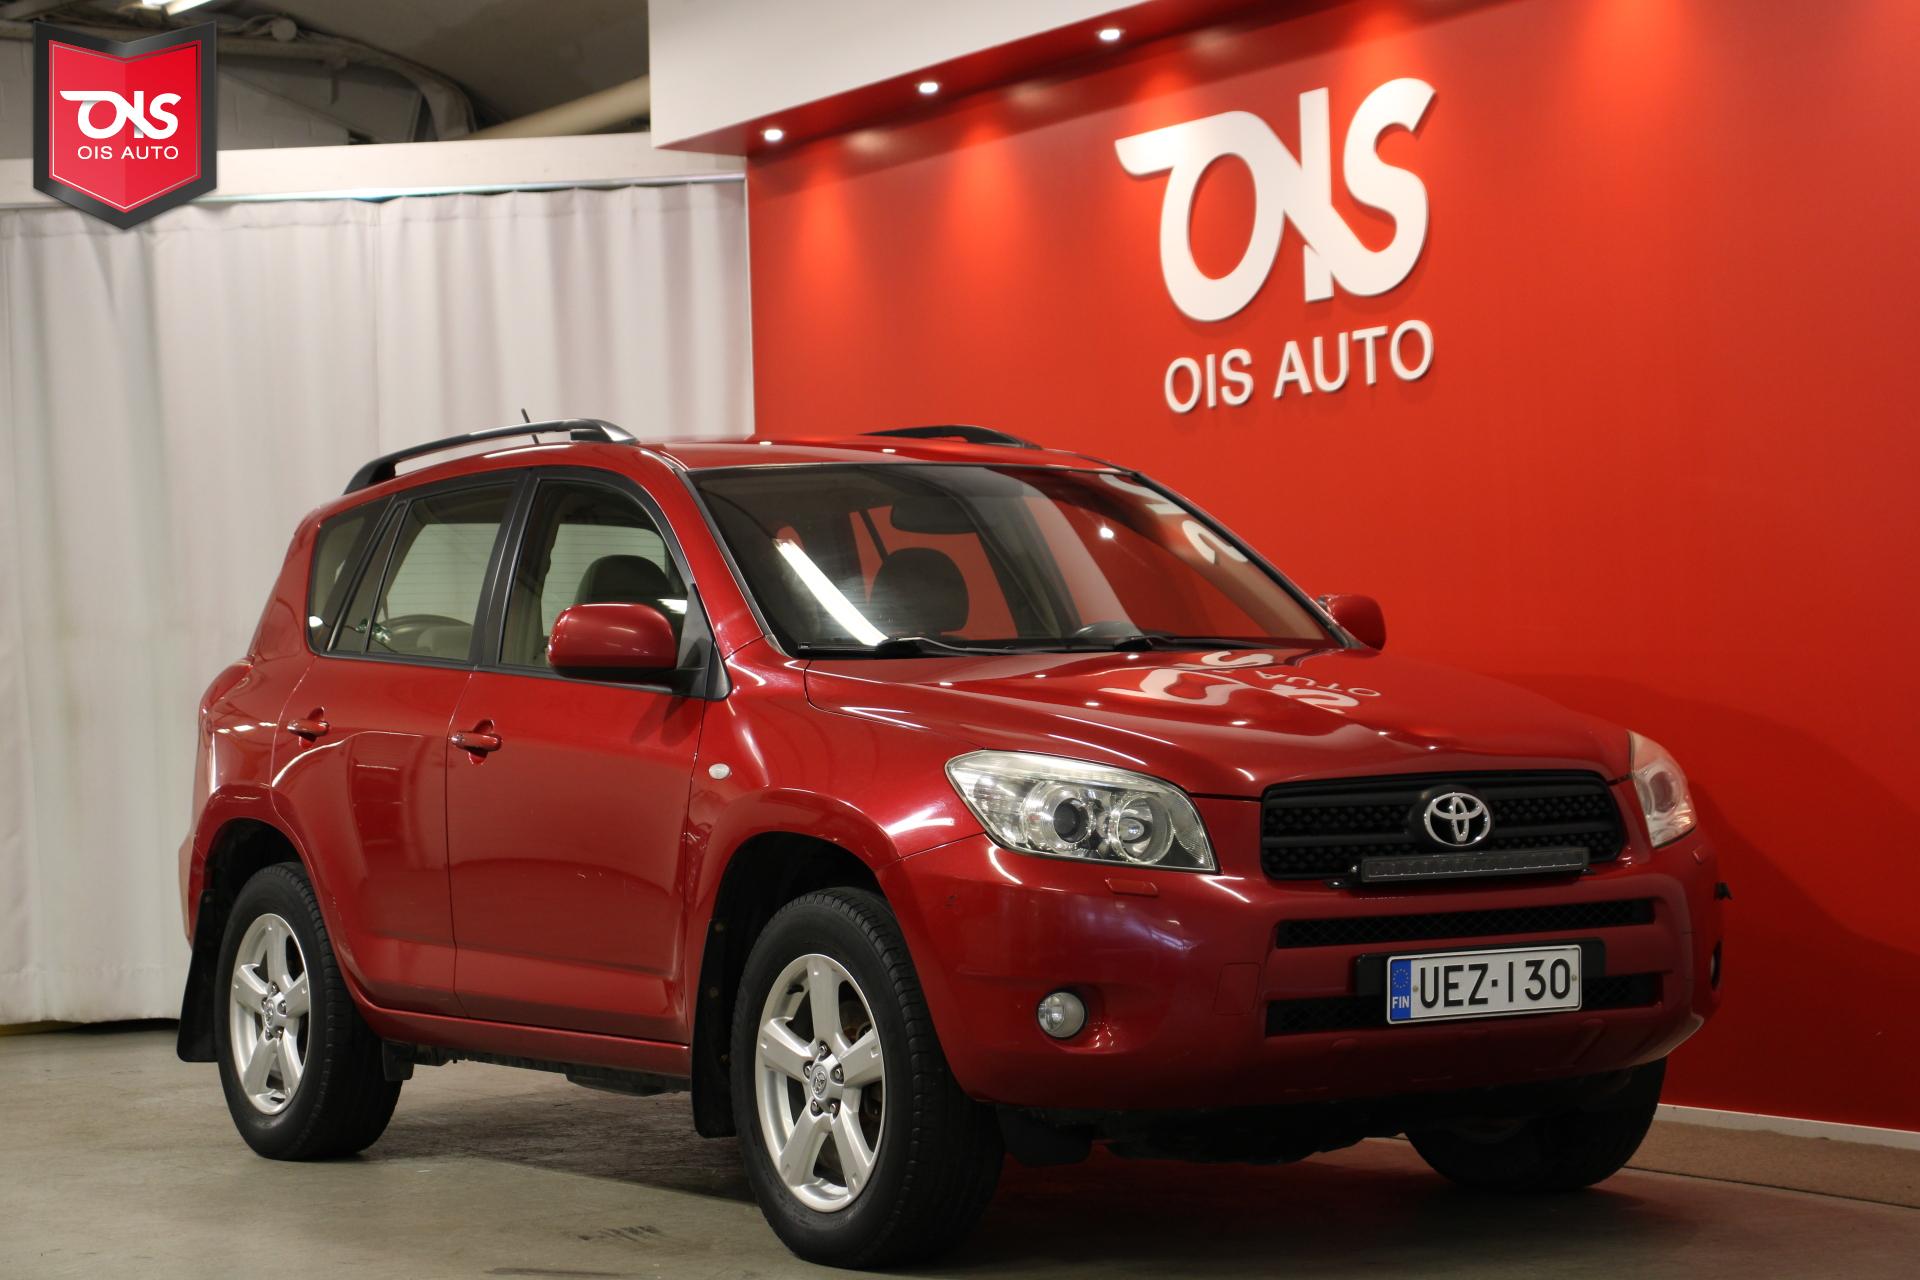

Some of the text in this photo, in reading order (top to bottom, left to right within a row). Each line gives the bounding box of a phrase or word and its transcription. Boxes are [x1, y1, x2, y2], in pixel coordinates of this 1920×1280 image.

[1114, 77, 1436, 322] OIS
[1164, 319, 1434, 414] OIS AUTO
[1392, 996, 1410, 1009] FIN
[1420, 958, 1571, 1008] UEZ-130
